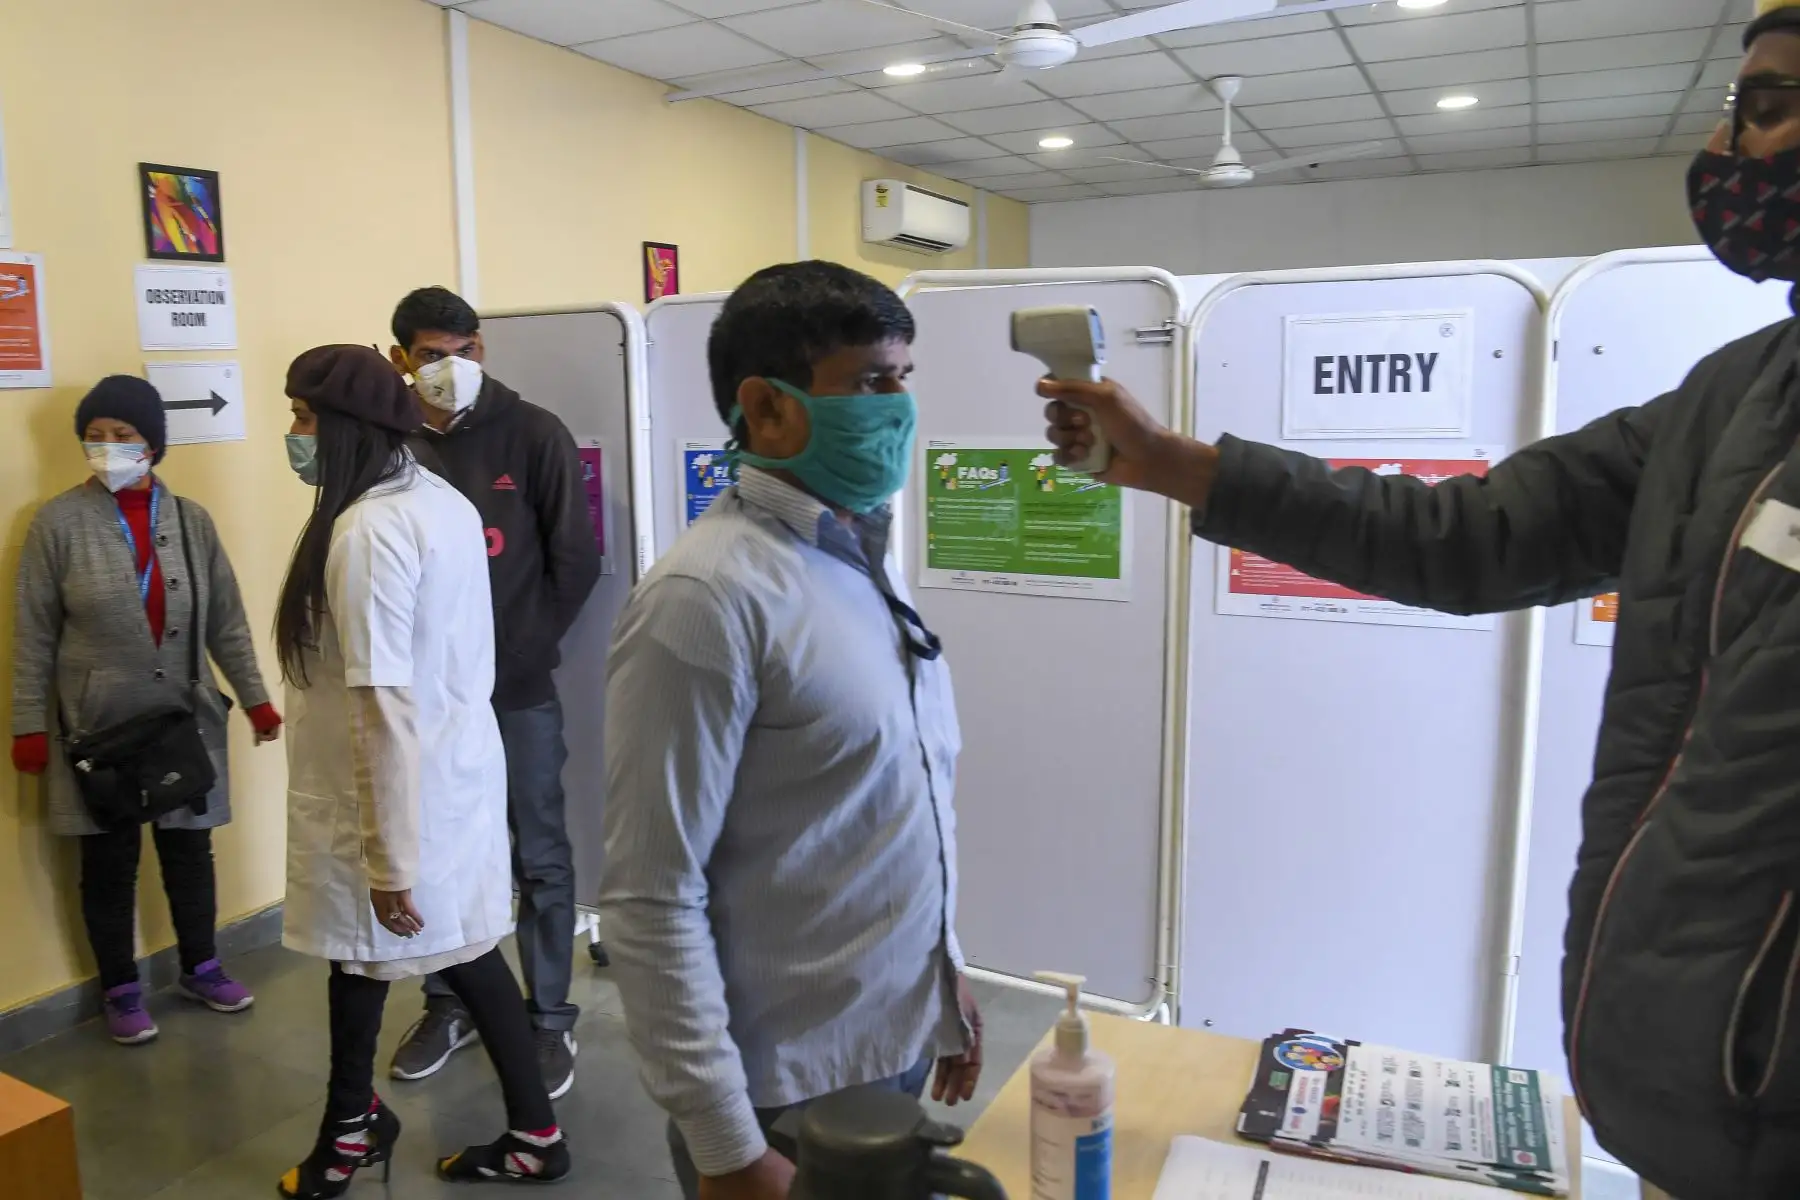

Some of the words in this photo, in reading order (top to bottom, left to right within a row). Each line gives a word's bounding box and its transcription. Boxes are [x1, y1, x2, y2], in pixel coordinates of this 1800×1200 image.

[146, 288, 226, 305] OBSERVATION
[171, 311, 208, 327] ROOM
[1313, 352, 1439, 395] ENTRY
[957, 466, 998, 480] FAQs
